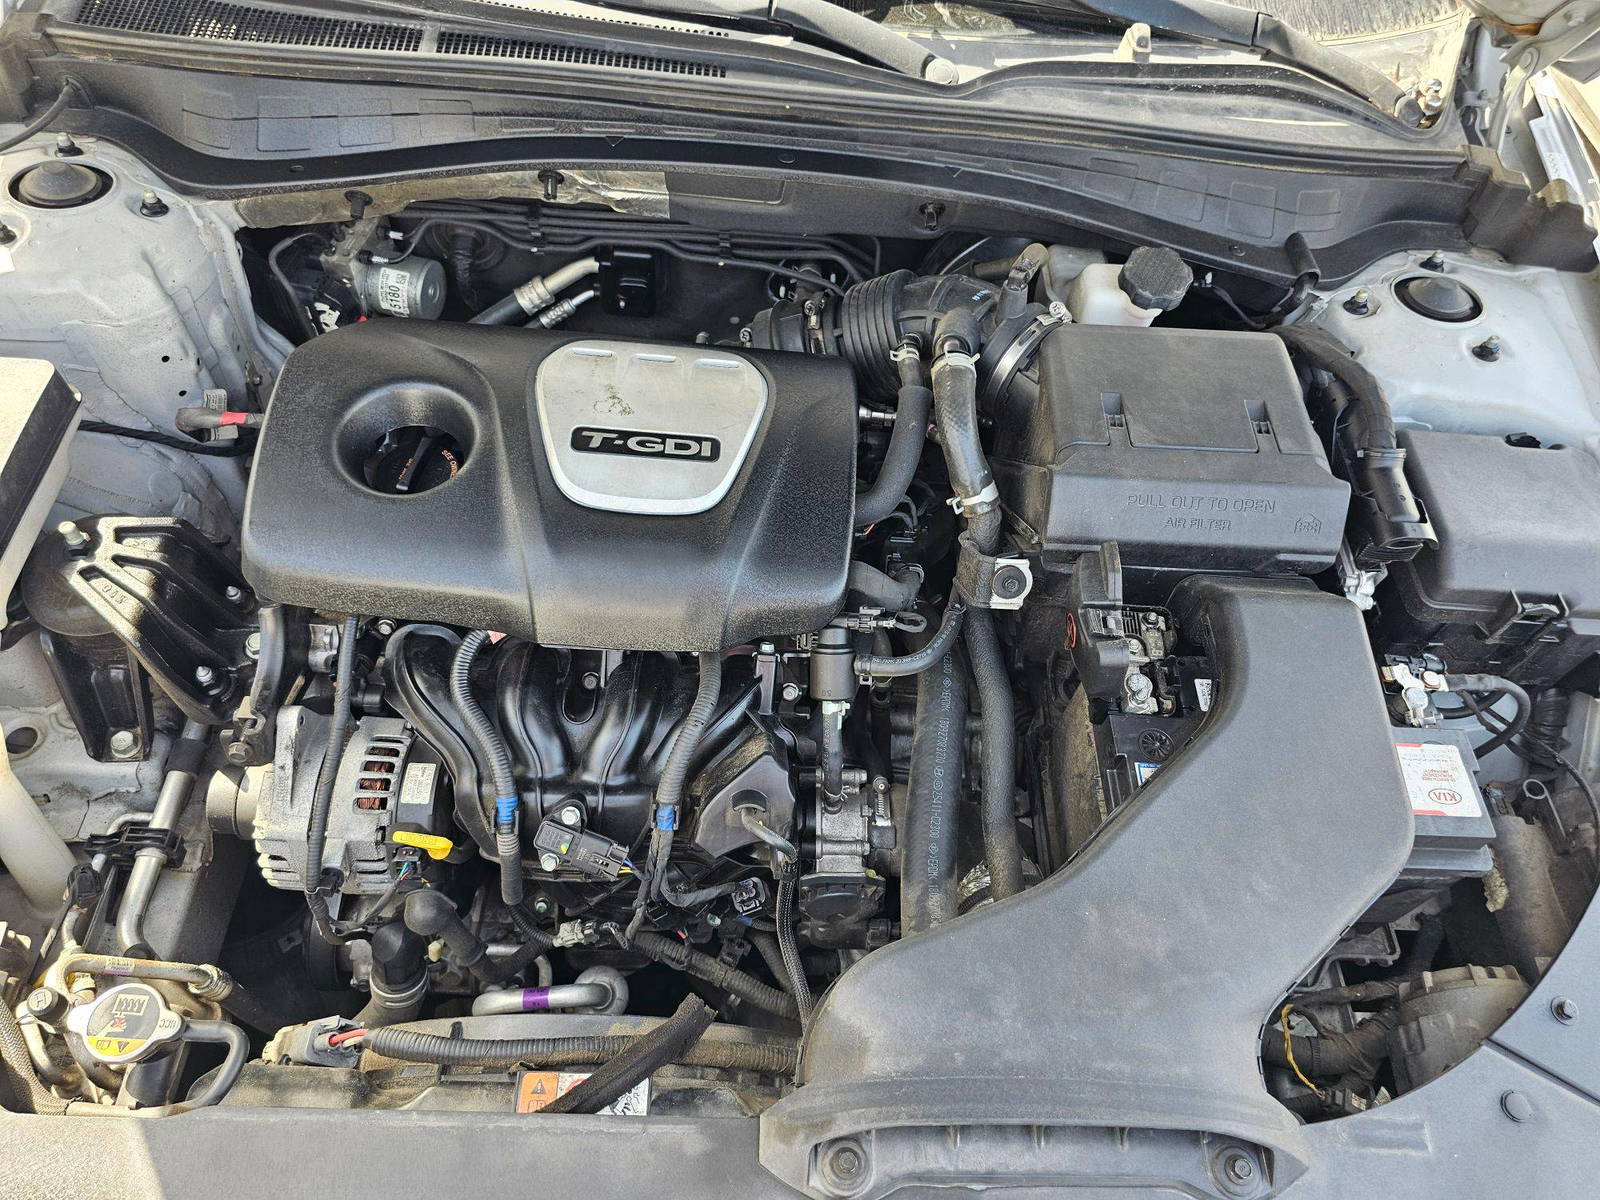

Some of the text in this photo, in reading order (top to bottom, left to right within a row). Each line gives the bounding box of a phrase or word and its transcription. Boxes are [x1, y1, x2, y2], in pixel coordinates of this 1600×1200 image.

[388, 284, 402, 310] 5180
[581, 431, 712, 457] T-GDI
[441, 449, 455, 461] SEE
[1127, 494, 1276, 513] PULL OUT TO OPEN
[1163, 516, 1232, 531] AIR FILTER
[1433, 791, 1458, 802] KIA
